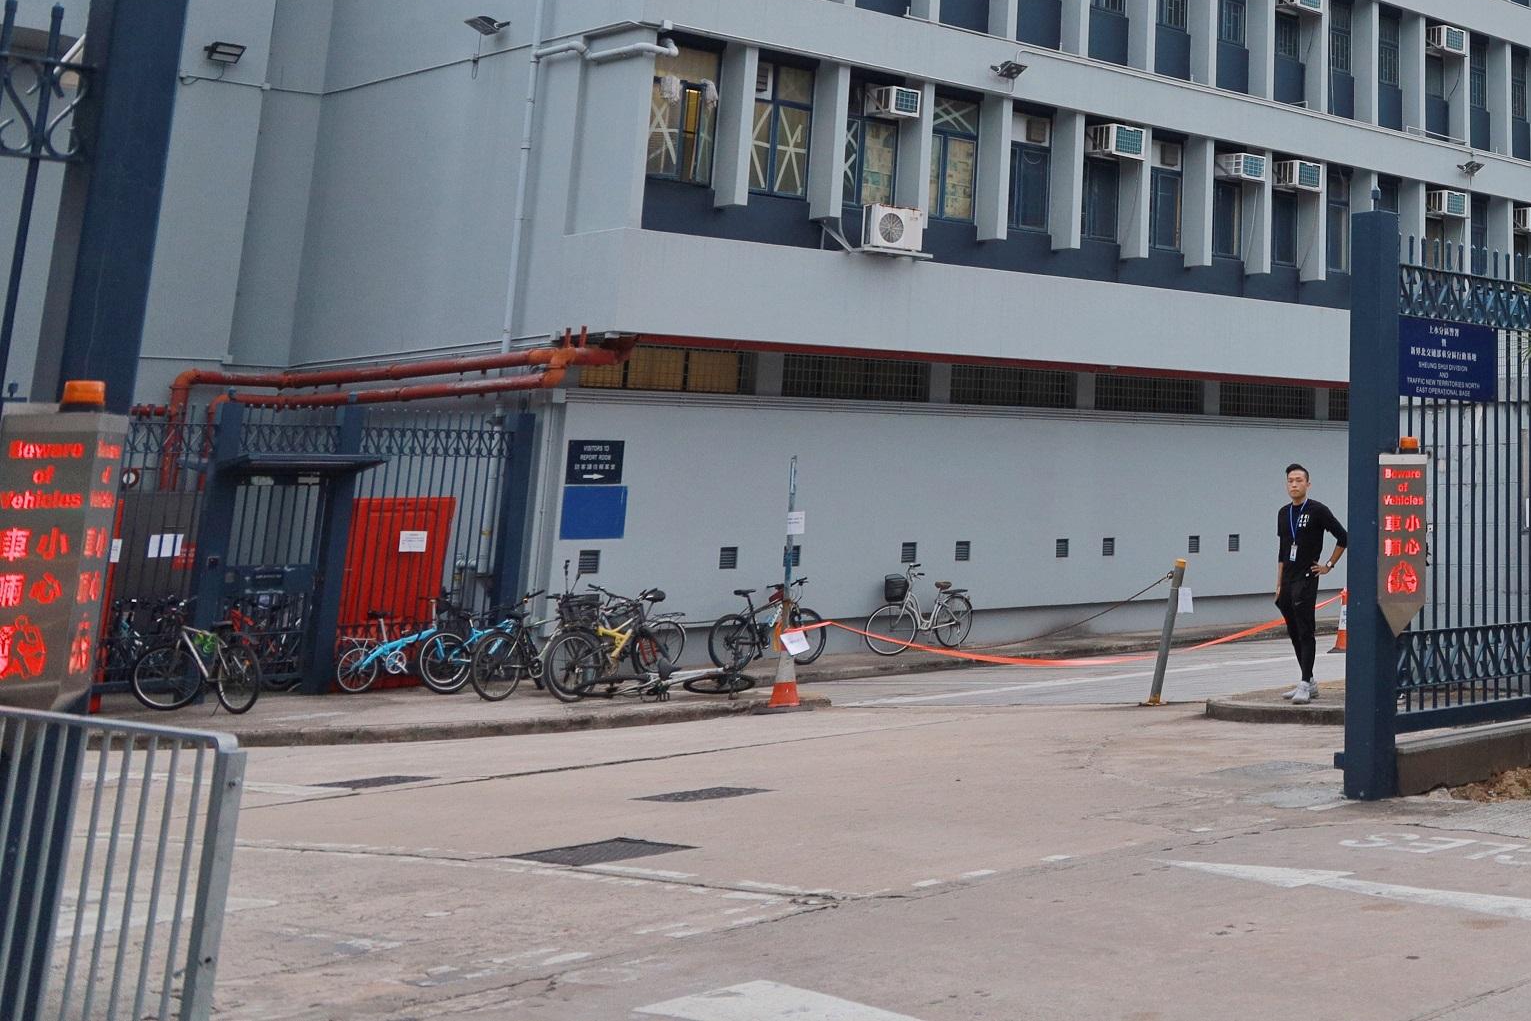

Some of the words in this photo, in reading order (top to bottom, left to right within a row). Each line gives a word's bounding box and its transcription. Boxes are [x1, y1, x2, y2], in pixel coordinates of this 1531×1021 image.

[1418, 361, 1437, 369] SHEUNG
[1449, 364, 1468, 372] DIVISION
[1439, 371, 1449, 379] AND
[1406, 377, 1426, 385] TRAFFIC
[1426, 378, 1436, 386] NEW
[1436, 379, 1465, 389] TERRITORIES
[1465, 381, 1480, 389] NORTH
[1416, 386, 1428, 394] EAST
[1428, 387, 1459, 396] OPERATIONAL
[1459, 389, 1471, 397] BASE
[32, 465, 55, 484] of
[1384, 468, 1421, 479] Beware
[1397, 482, 1409, 492] of
[1384, 495, 1424, 506] Vehicles
